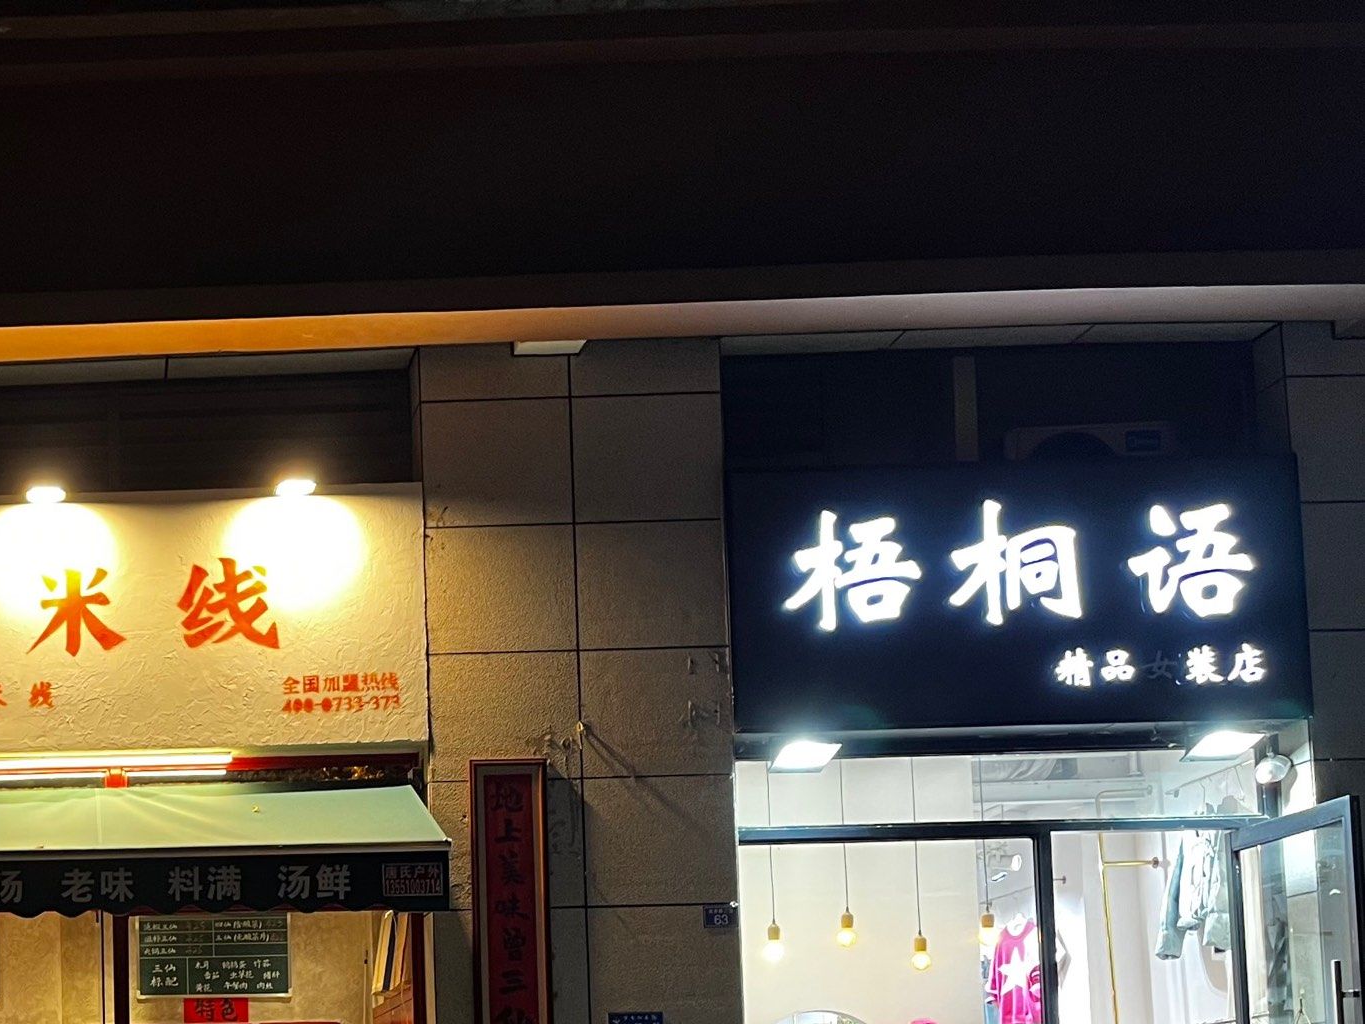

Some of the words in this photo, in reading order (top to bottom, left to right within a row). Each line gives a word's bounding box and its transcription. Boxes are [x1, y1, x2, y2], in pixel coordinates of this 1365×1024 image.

[782, 499, 1255, 632] 梧桐语
[282, 672, 399, 695] 全国加盟热线
[61, 868, 134, 903] 老味
[168, 865, 241, 901] 料满
[277, 864, 352, 900] 汤鲜
[152, 964, 176, 973] 三仙
